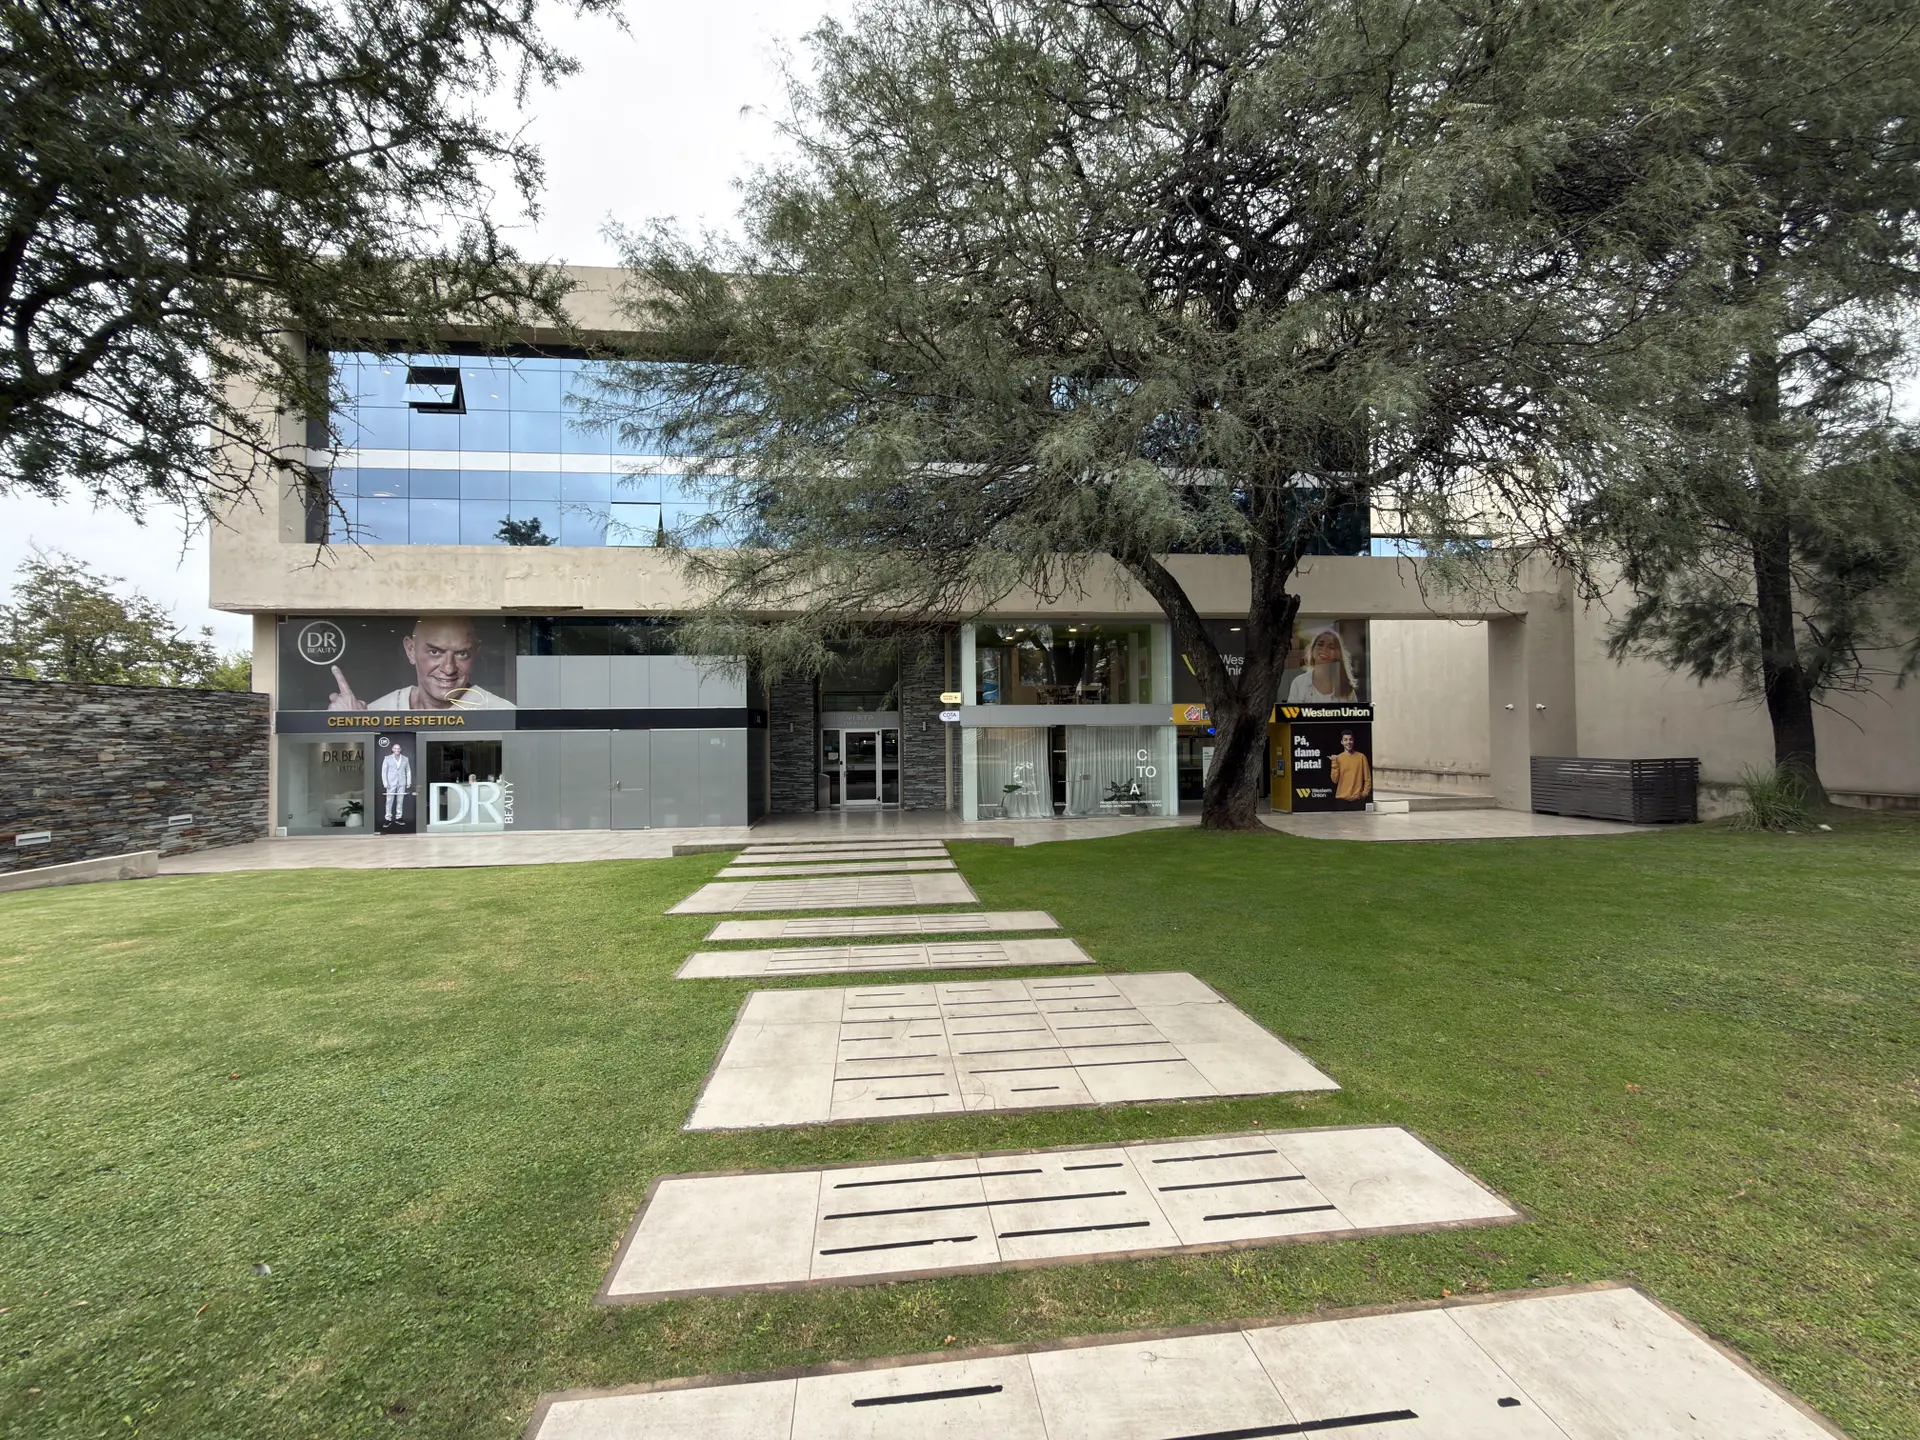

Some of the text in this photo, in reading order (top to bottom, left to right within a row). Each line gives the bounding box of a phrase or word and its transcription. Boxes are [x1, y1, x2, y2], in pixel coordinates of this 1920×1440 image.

[307, 631, 337, 648] DR
[1301, 706, 1370, 717] Western Union
[327, 715, 465, 727] CENTRO DE ESTETICA
[1294, 735, 1310, 747] Pá,
[1294, 747, 1321, 757] dame
[1136, 765, 1157, 778] TO
[1294, 759, 1322, 772] plata!
[429, 781, 504, 826] DR
[504, 780, 514, 824] BEAUTY
